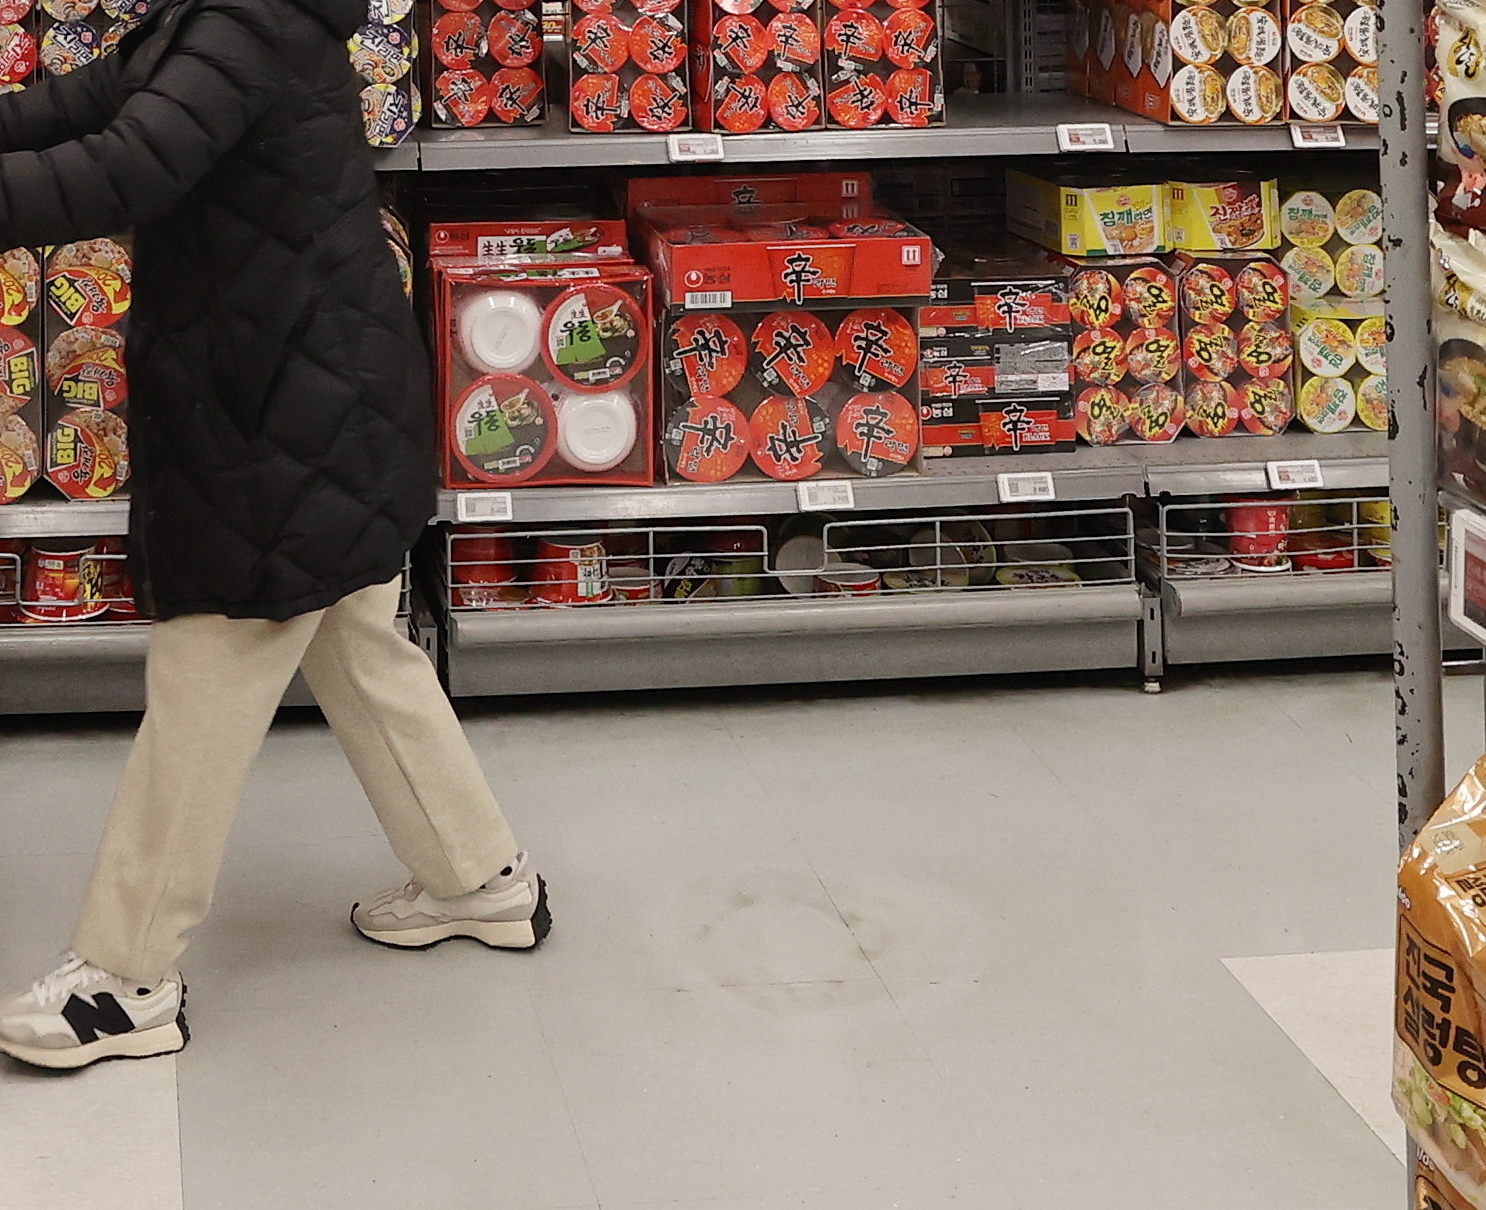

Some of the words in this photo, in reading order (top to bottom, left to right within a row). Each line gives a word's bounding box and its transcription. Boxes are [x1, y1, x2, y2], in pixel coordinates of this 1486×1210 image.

[49, 277, 86, 316] BIG
[783, 253, 820, 305] 辛
[998, 289, 1028, 332] 辛
[856, 323, 893, 377] 辛
[855, 406, 891, 459] 辛
[1002, 403, 1031, 449] 辛
[1404, 934, 1460, 1012] 진국
